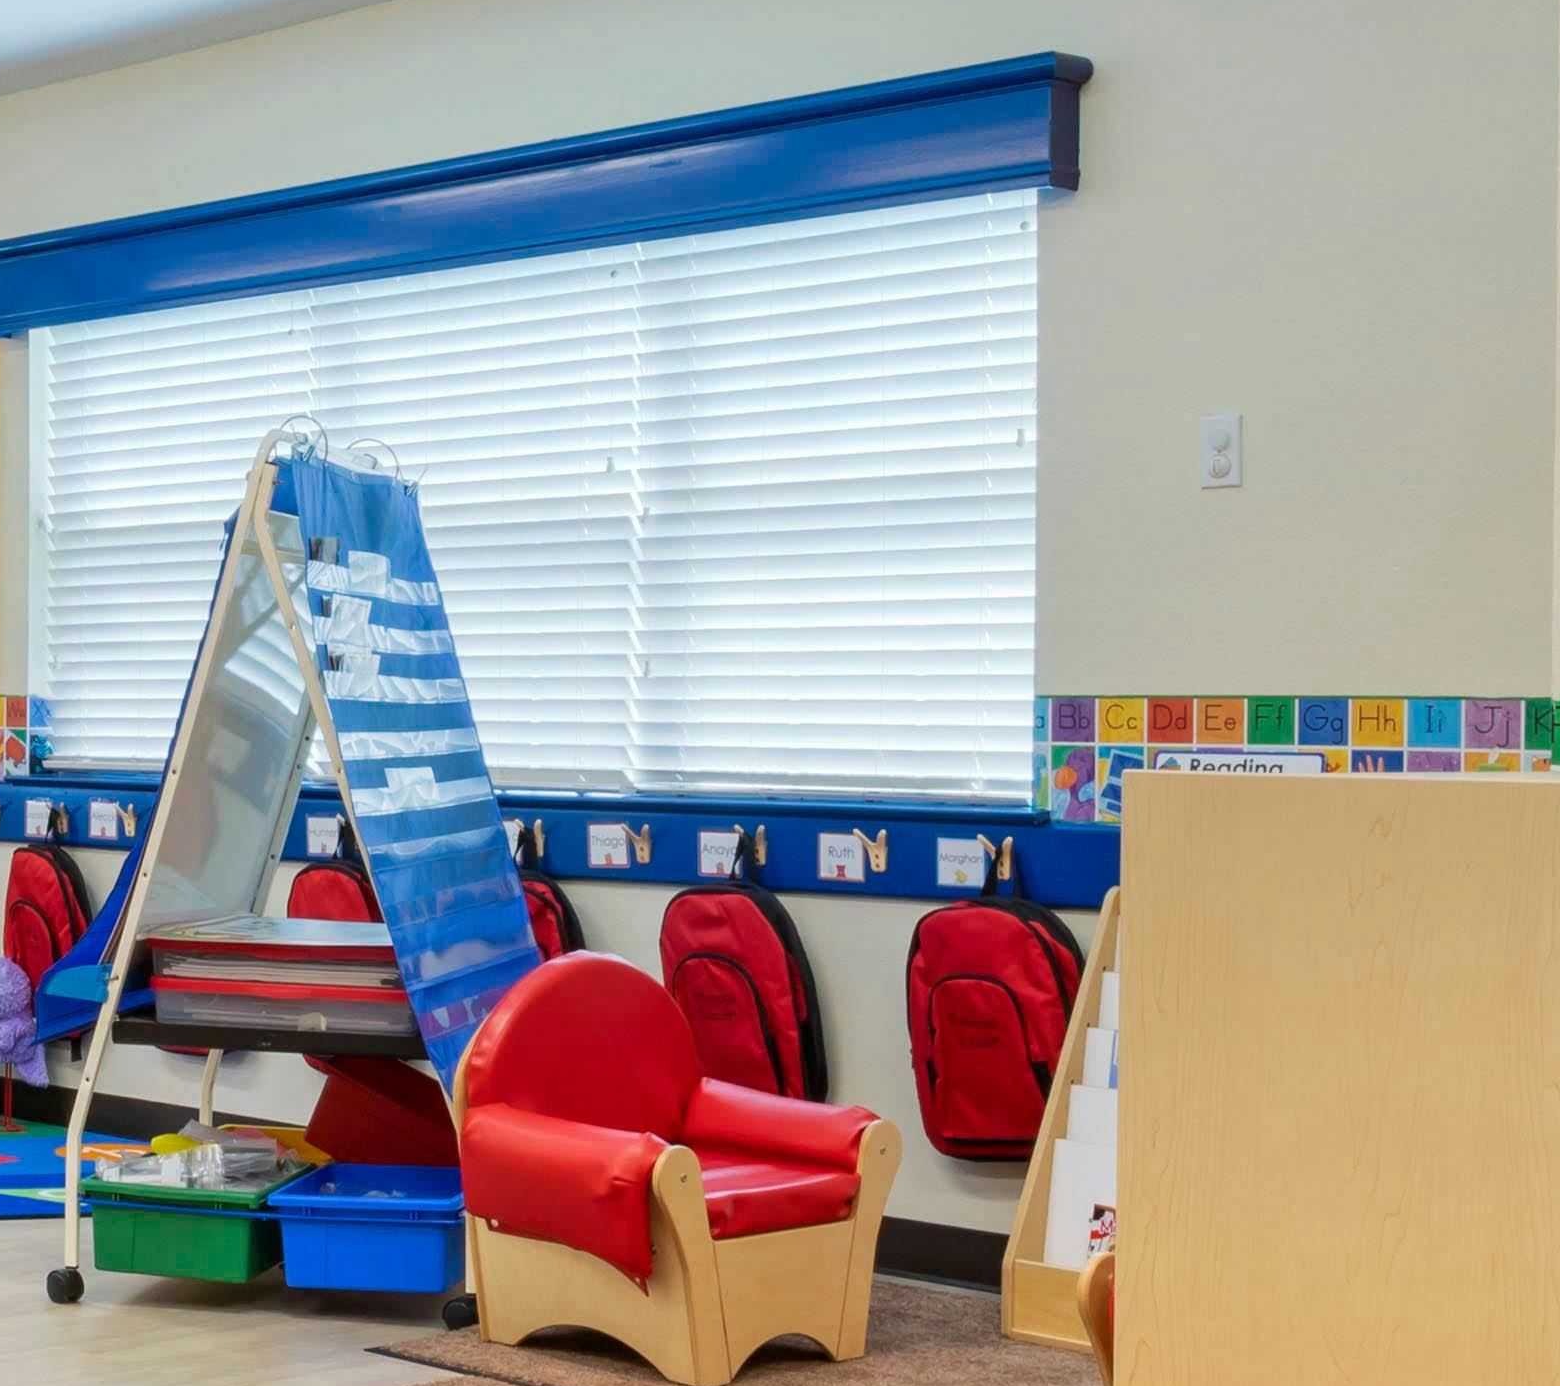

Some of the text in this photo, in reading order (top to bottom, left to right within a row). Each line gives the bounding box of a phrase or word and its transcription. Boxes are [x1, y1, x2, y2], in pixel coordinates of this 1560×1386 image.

[1057, 703, 1091, 731] Bb
[1104, 703, 1138, 732] Cc
[1152, 703, 1188, 732] Dd
[1204, 703, 1237, 732] Ee
[1254, 702, 1287, 732] Ff
[1303, 703, 1345, 745] Gg
[1358, 703, 1397, 733] Hh
[1424, 703, 1444, 735] Ii
[1474, 705, 1510, 748] Jj
[591, 833, 626, 850] Thiago
[827, 844, 856, 860] Ruth
